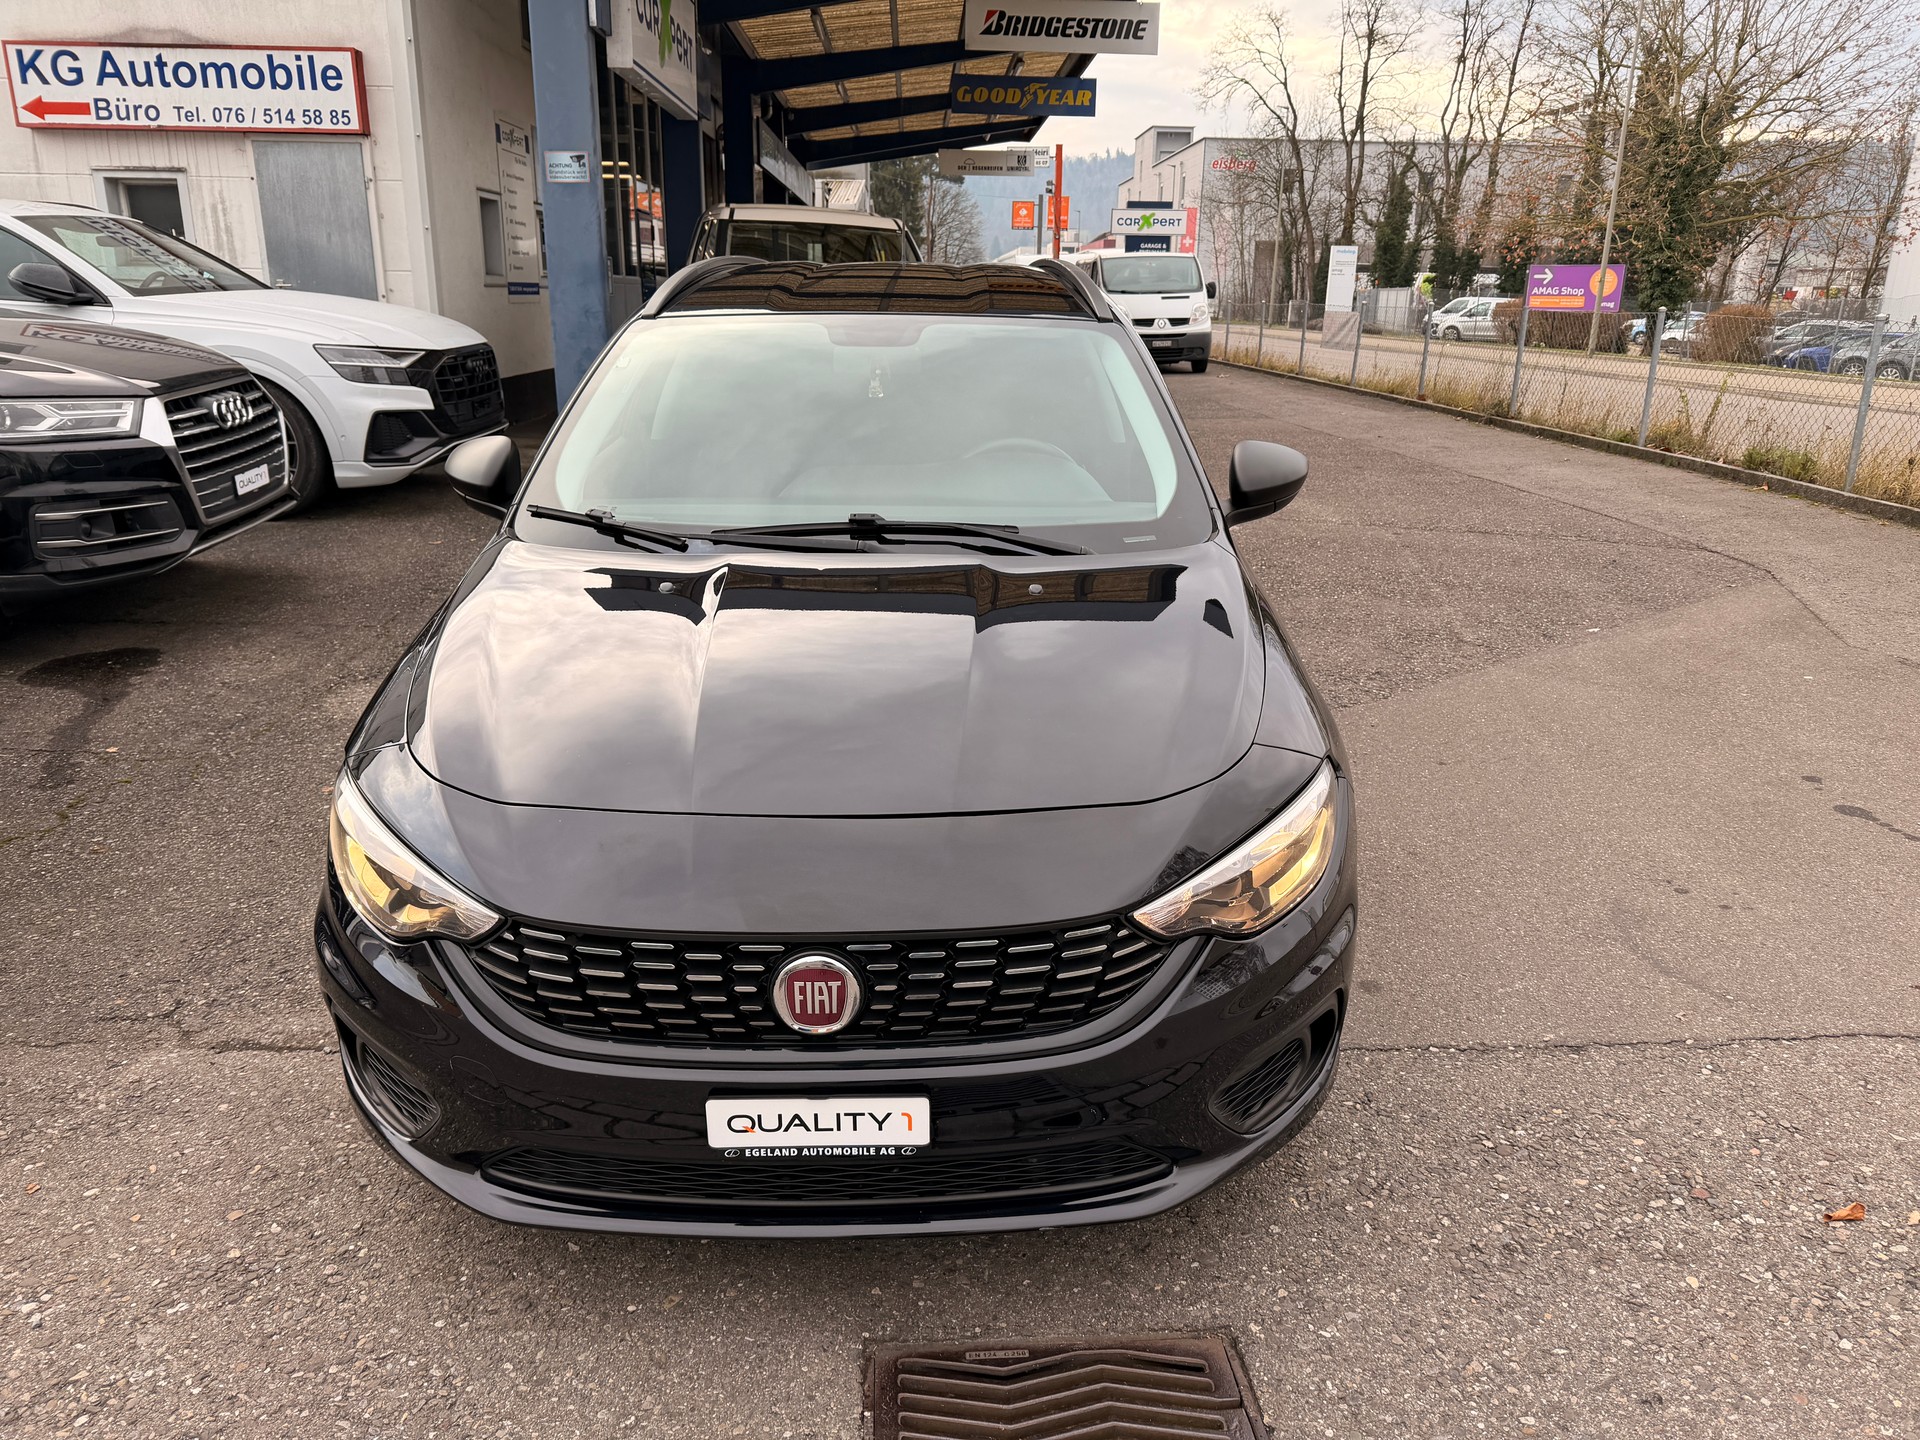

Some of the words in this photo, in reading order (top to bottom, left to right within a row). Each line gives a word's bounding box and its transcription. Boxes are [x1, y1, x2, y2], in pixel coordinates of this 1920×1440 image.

[979, 9, 1149, 40] BRIDGESTONE
[15, 48, 84, 87] KG
[95, 50, 344, 91] Automobile
[93, 97, 161, 122] Büro
[173, 106, 206, 122] Tel.
[212, 107, 245, 123] 076
[251, 107, 257, 124] /
[263, 107, 296, 125] 514
[302, 108, 323, 125] 58
[330, 109, 351, 126] 85
[1212, 156, 1256, 170] eisberg
[1531, 286, 1559, 295] AMAG
[1561, 286, 1585, 296] Shop
[238, 474, 263, 489] QUALITY
[793, 981, 842, 1014] FIAT
[726, 1112, 893, 1133] QUALITY
[901, 1112, 913, 1131] 1
[745, 1148, 798, 1157] EGELAND
[801, 1148, 876, 1156] AUTOMOBILE
[880, 1147, 896, 1156] AG
